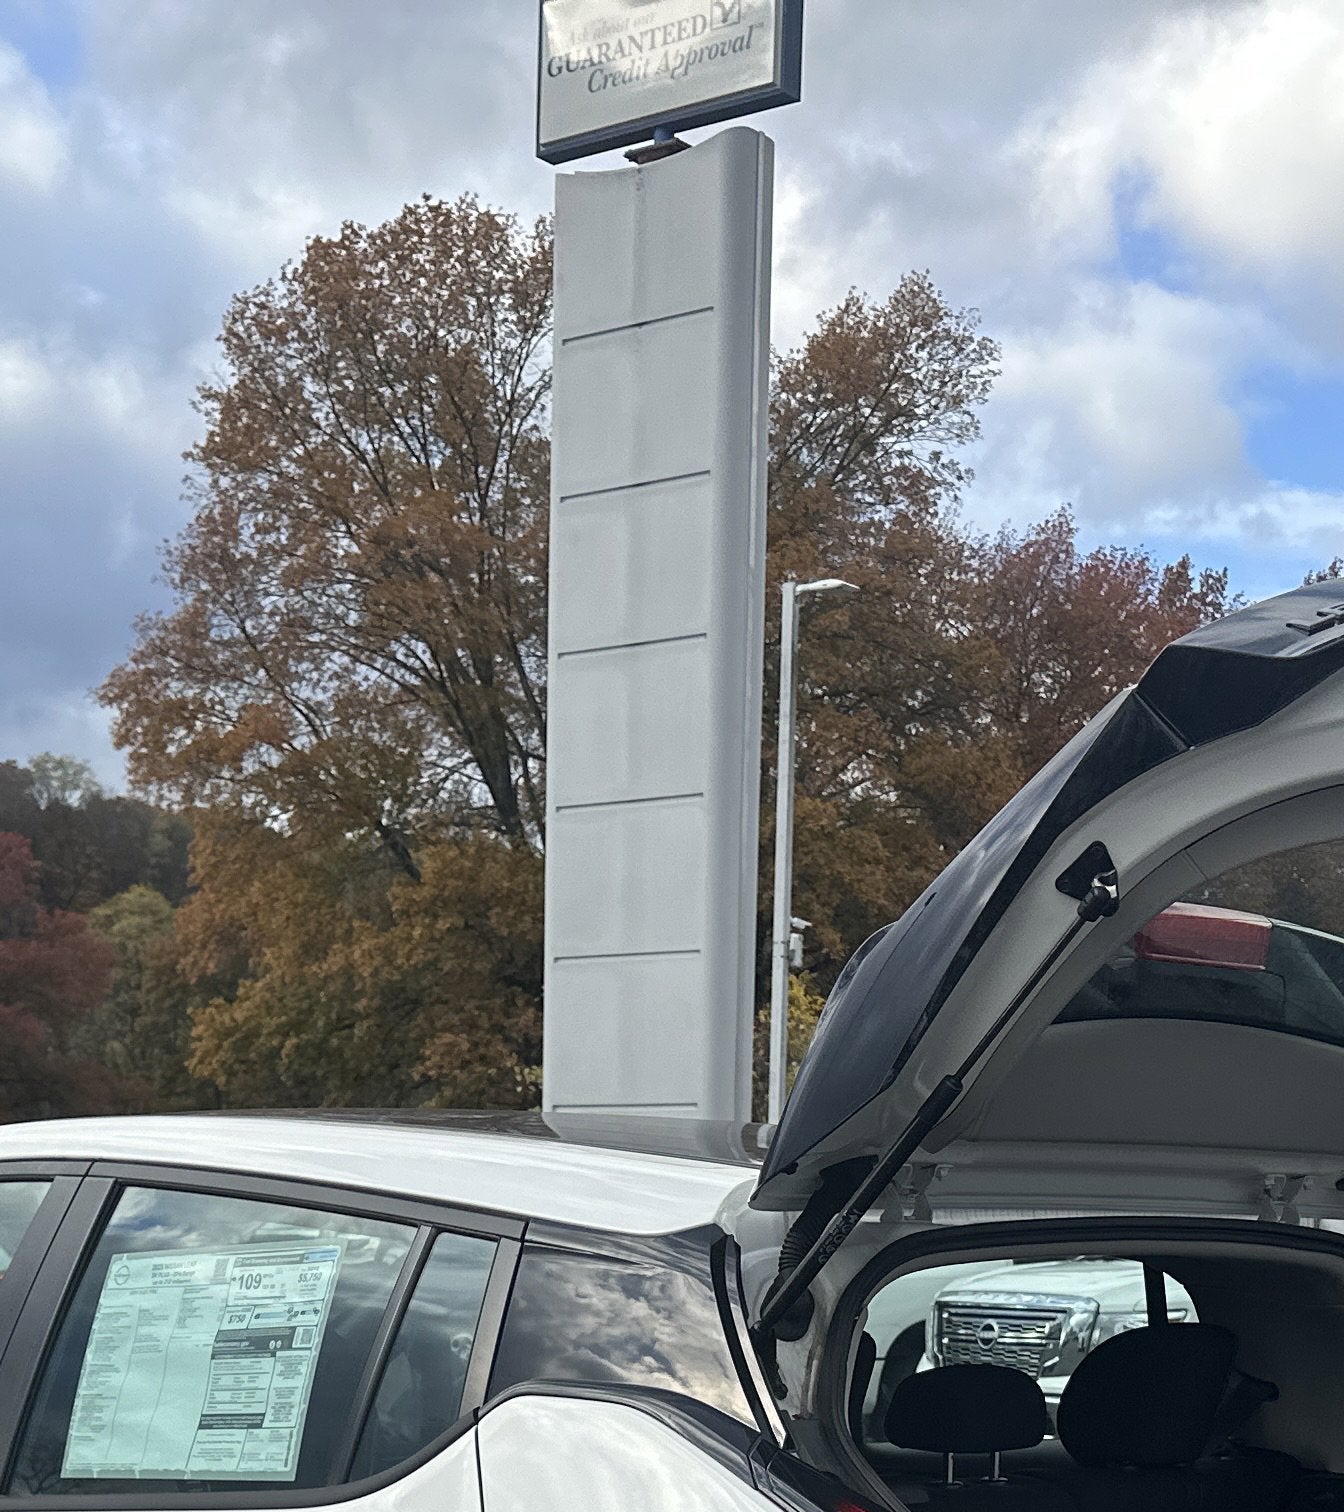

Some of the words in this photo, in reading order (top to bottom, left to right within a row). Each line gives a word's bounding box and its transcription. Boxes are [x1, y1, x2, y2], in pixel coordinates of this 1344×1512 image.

[548, 14, 707, 78] GUARANTEED
[588, 54, 650, 93] Credit
[656, 25, 754, 80] Approval
[238, 1273, 262, 1290] 109
[298, 1271, 323, 1283] $5,750
[228, 1313, 247, 1324] $750
